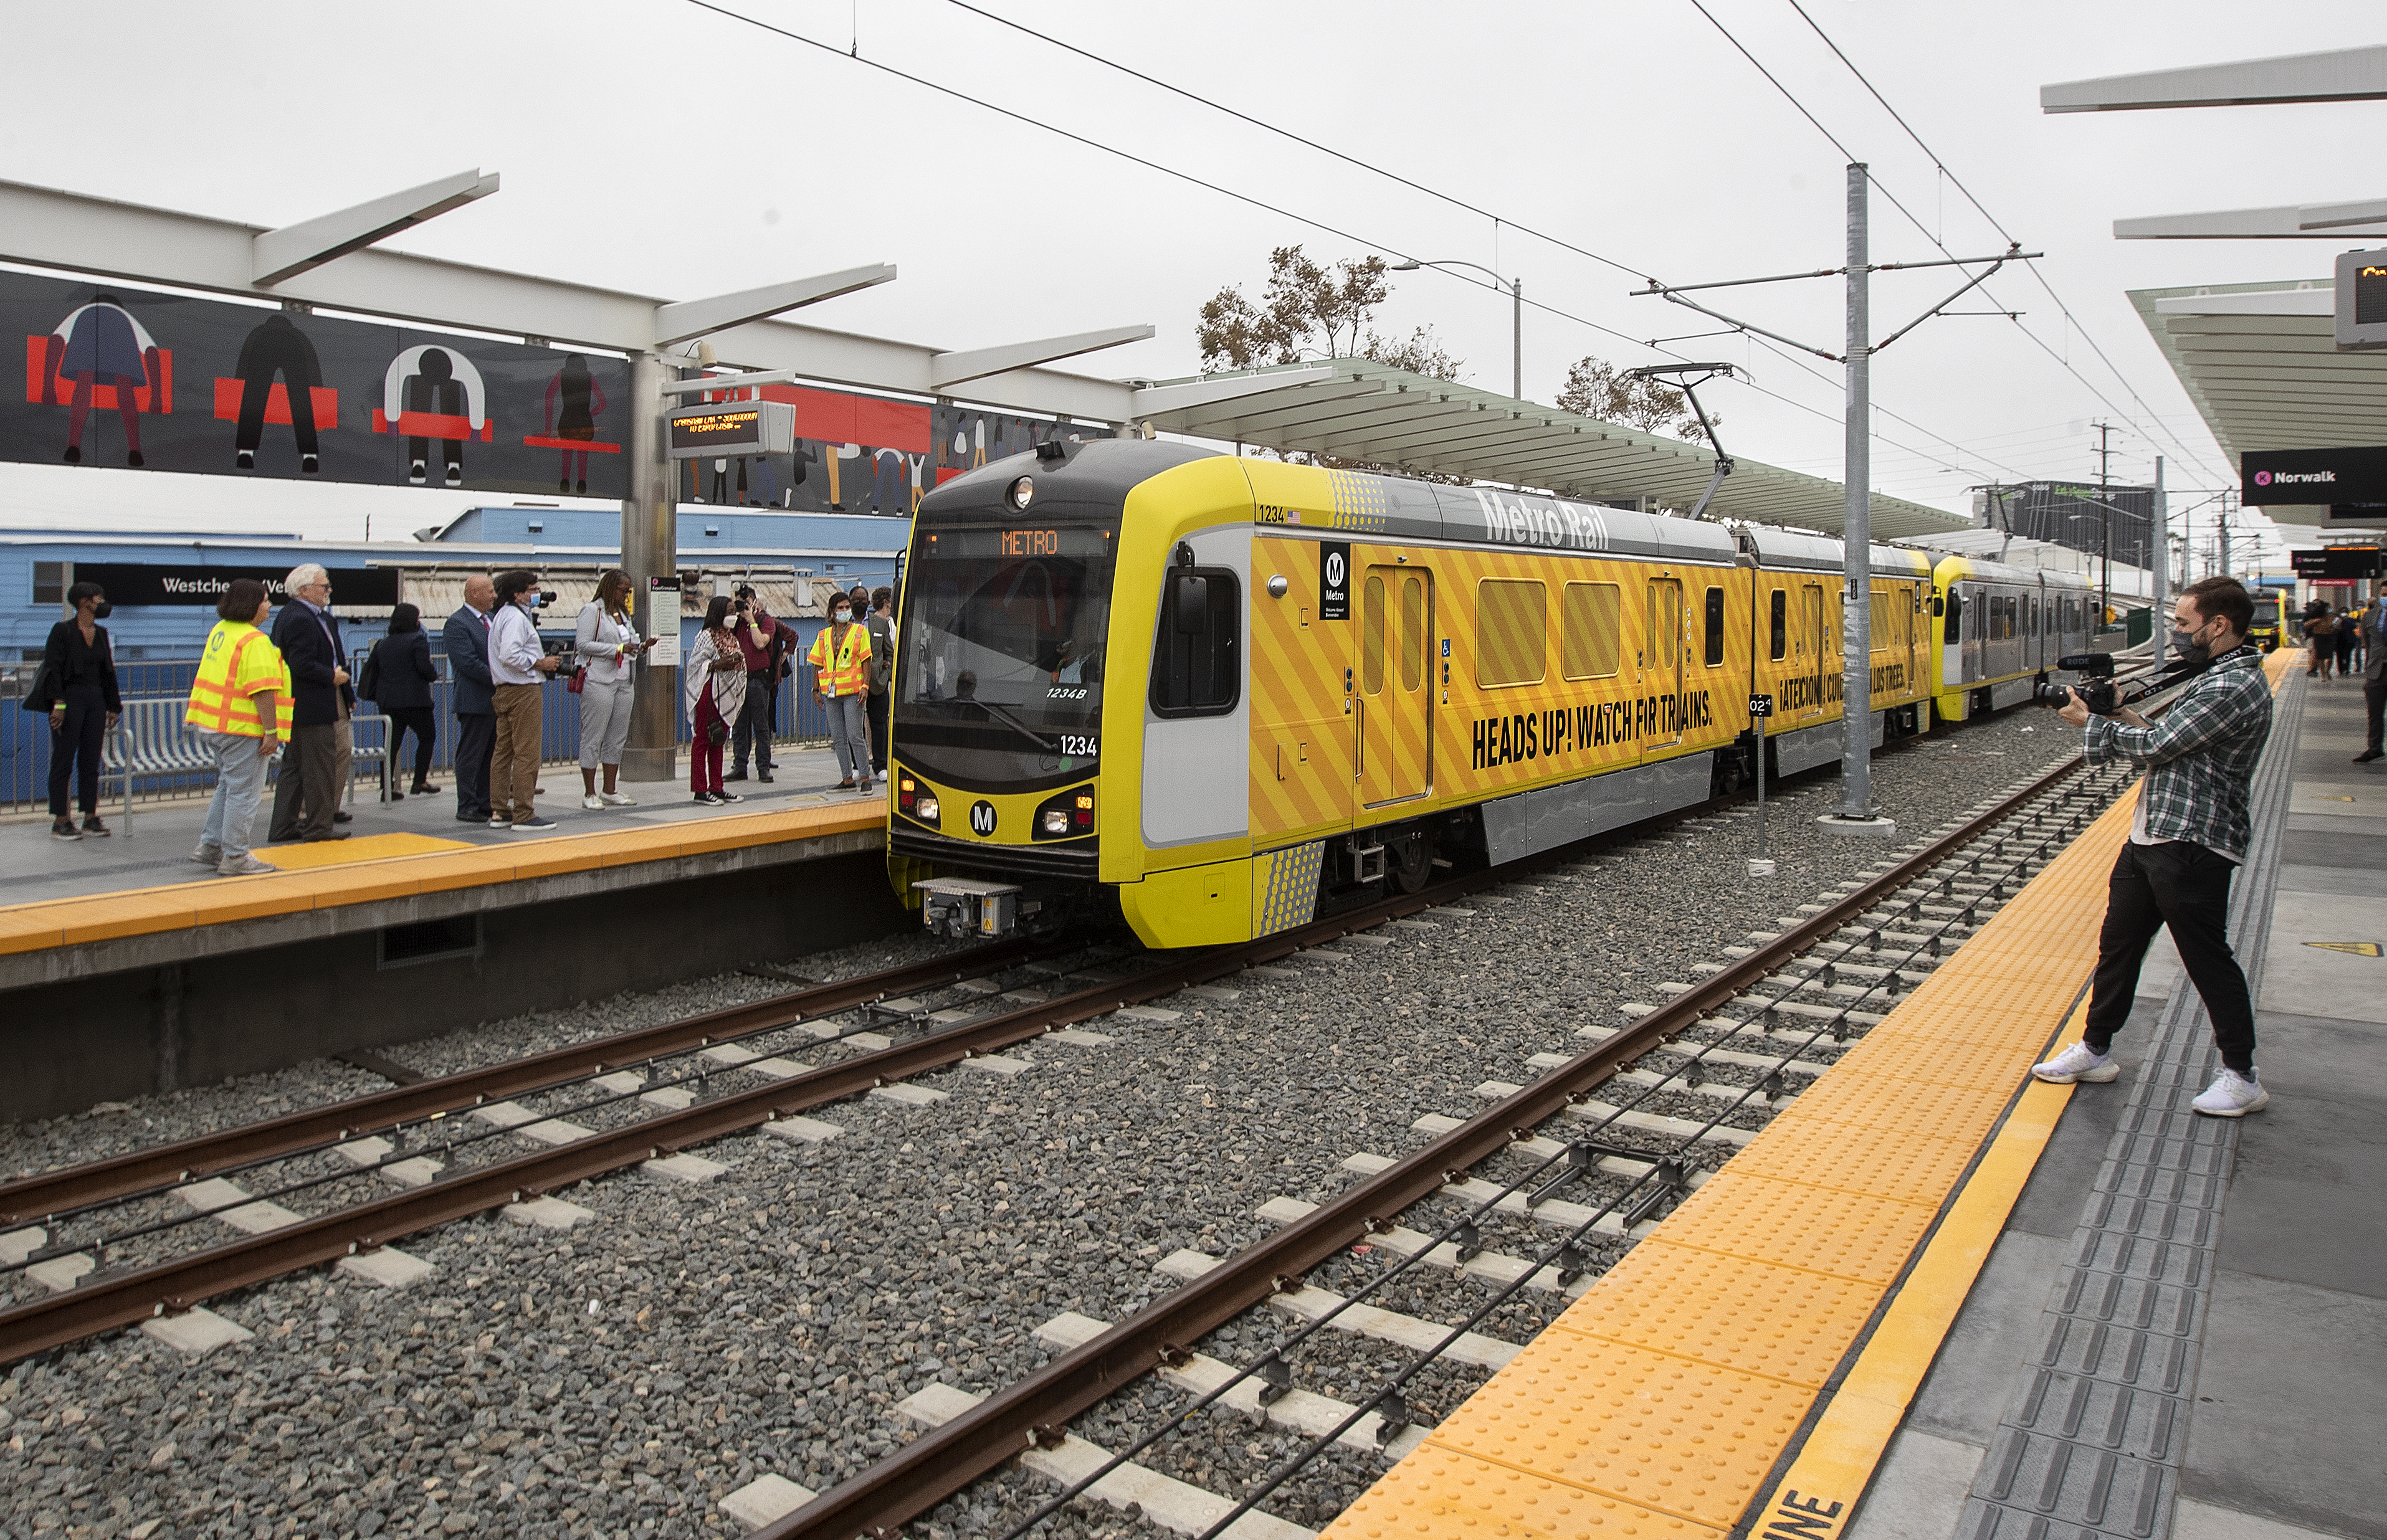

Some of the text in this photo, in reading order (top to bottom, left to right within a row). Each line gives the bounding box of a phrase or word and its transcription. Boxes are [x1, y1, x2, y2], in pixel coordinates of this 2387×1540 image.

[2274, 470, 2336, 483] Norwalk
[1260, 505, 1284, 523] 1234
[1474, 490, 1609, 550] Metro Rail
[1002, 530, 1057, 554] METRO
[1326, 589, 1344, 601] Metro
[2216, 649, 2242, 664] SONY
[1047, 688, 1087, 699] 1234B
[1472, 712, 1537, 770] HEADS
[1542, 708, 1572, 756] UP!
[1577, 700, 1632, 750] WATCH
[1660, 690, 1712, 734] TRAINS.
[1060, 735, 1097, 756] 1234
